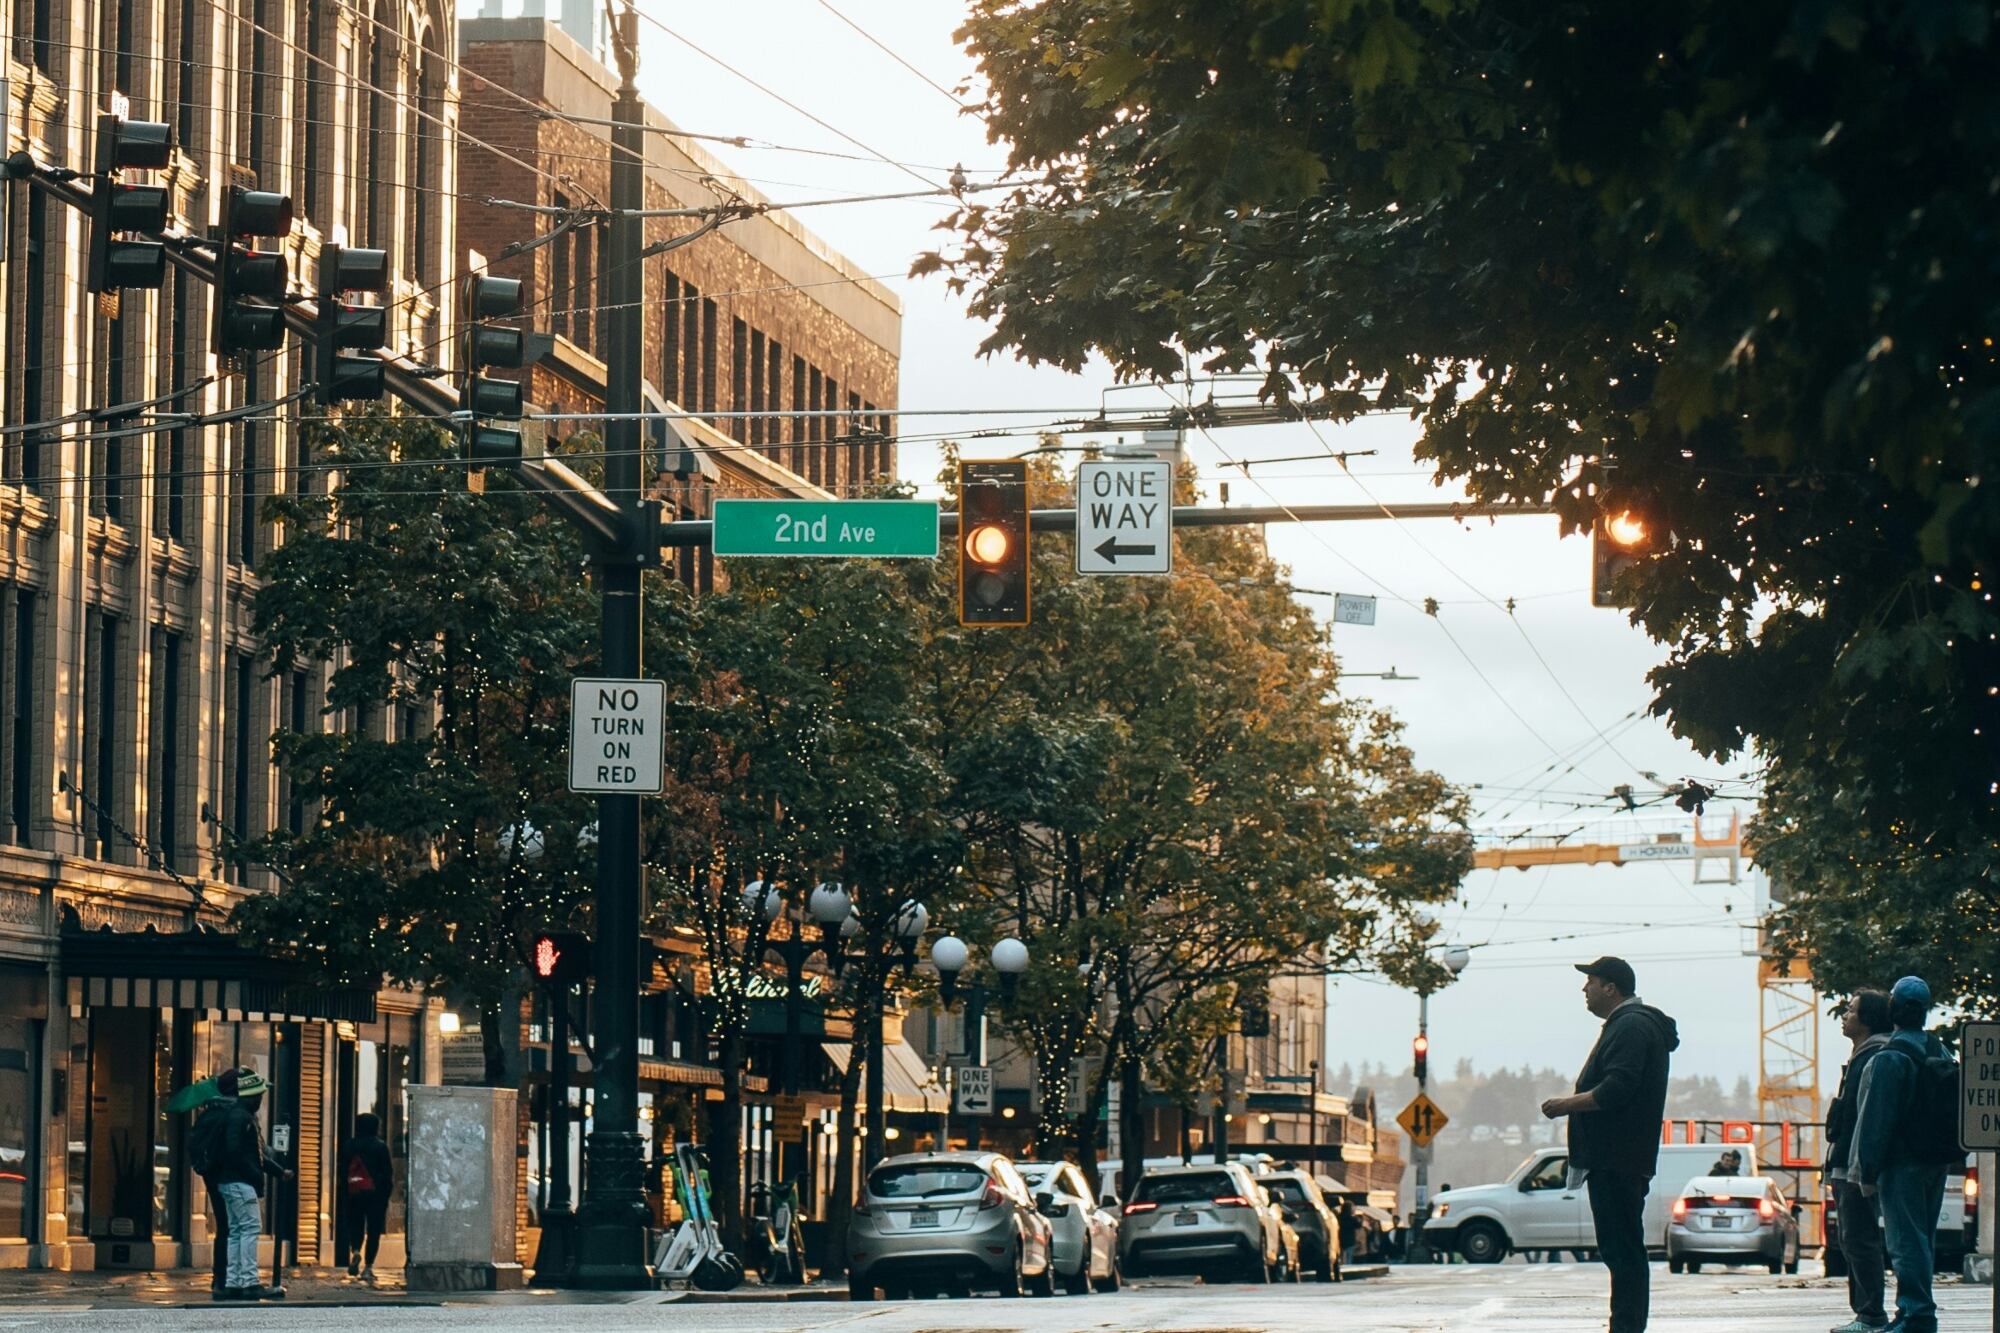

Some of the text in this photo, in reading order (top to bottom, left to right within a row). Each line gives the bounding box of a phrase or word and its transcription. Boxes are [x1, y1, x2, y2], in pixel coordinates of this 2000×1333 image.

[1094, 471, 1156, 497] ONE
[1091, 503, 1158, 529] WAY
[775, 513, 876, 542] 2nd Ave
[1339, 600, 1371, 612] POWER
[599, 689, 638, 711] NO
[592, 717, 644, 735] TURN
[603, 742, 630, 759] ON
[598, 766, 636, 783] RED
[1973, 1038, 2000, 1056] PO
[962, 1070, 989, 1082] ONE
[961, 1083, 989, 1095] WAY
